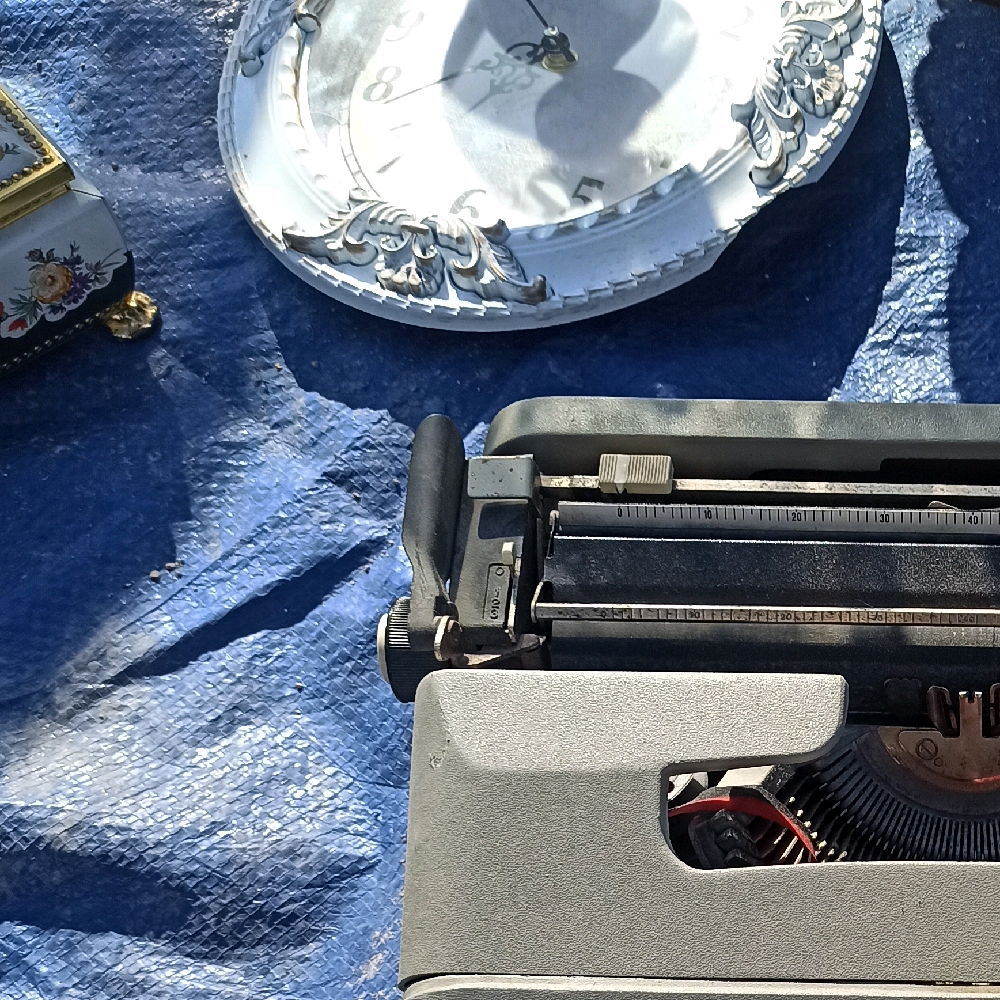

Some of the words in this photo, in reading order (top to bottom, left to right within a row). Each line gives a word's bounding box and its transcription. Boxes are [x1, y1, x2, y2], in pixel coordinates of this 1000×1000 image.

[362, 65, 402, 102] 8
[617, 507, 623, 518] 0
[703, 508, 713, 520] 10
[791, 512, 802, 522] 20
[879, 513, 890, 523] 30
[967, 514, 979, 525] 40
